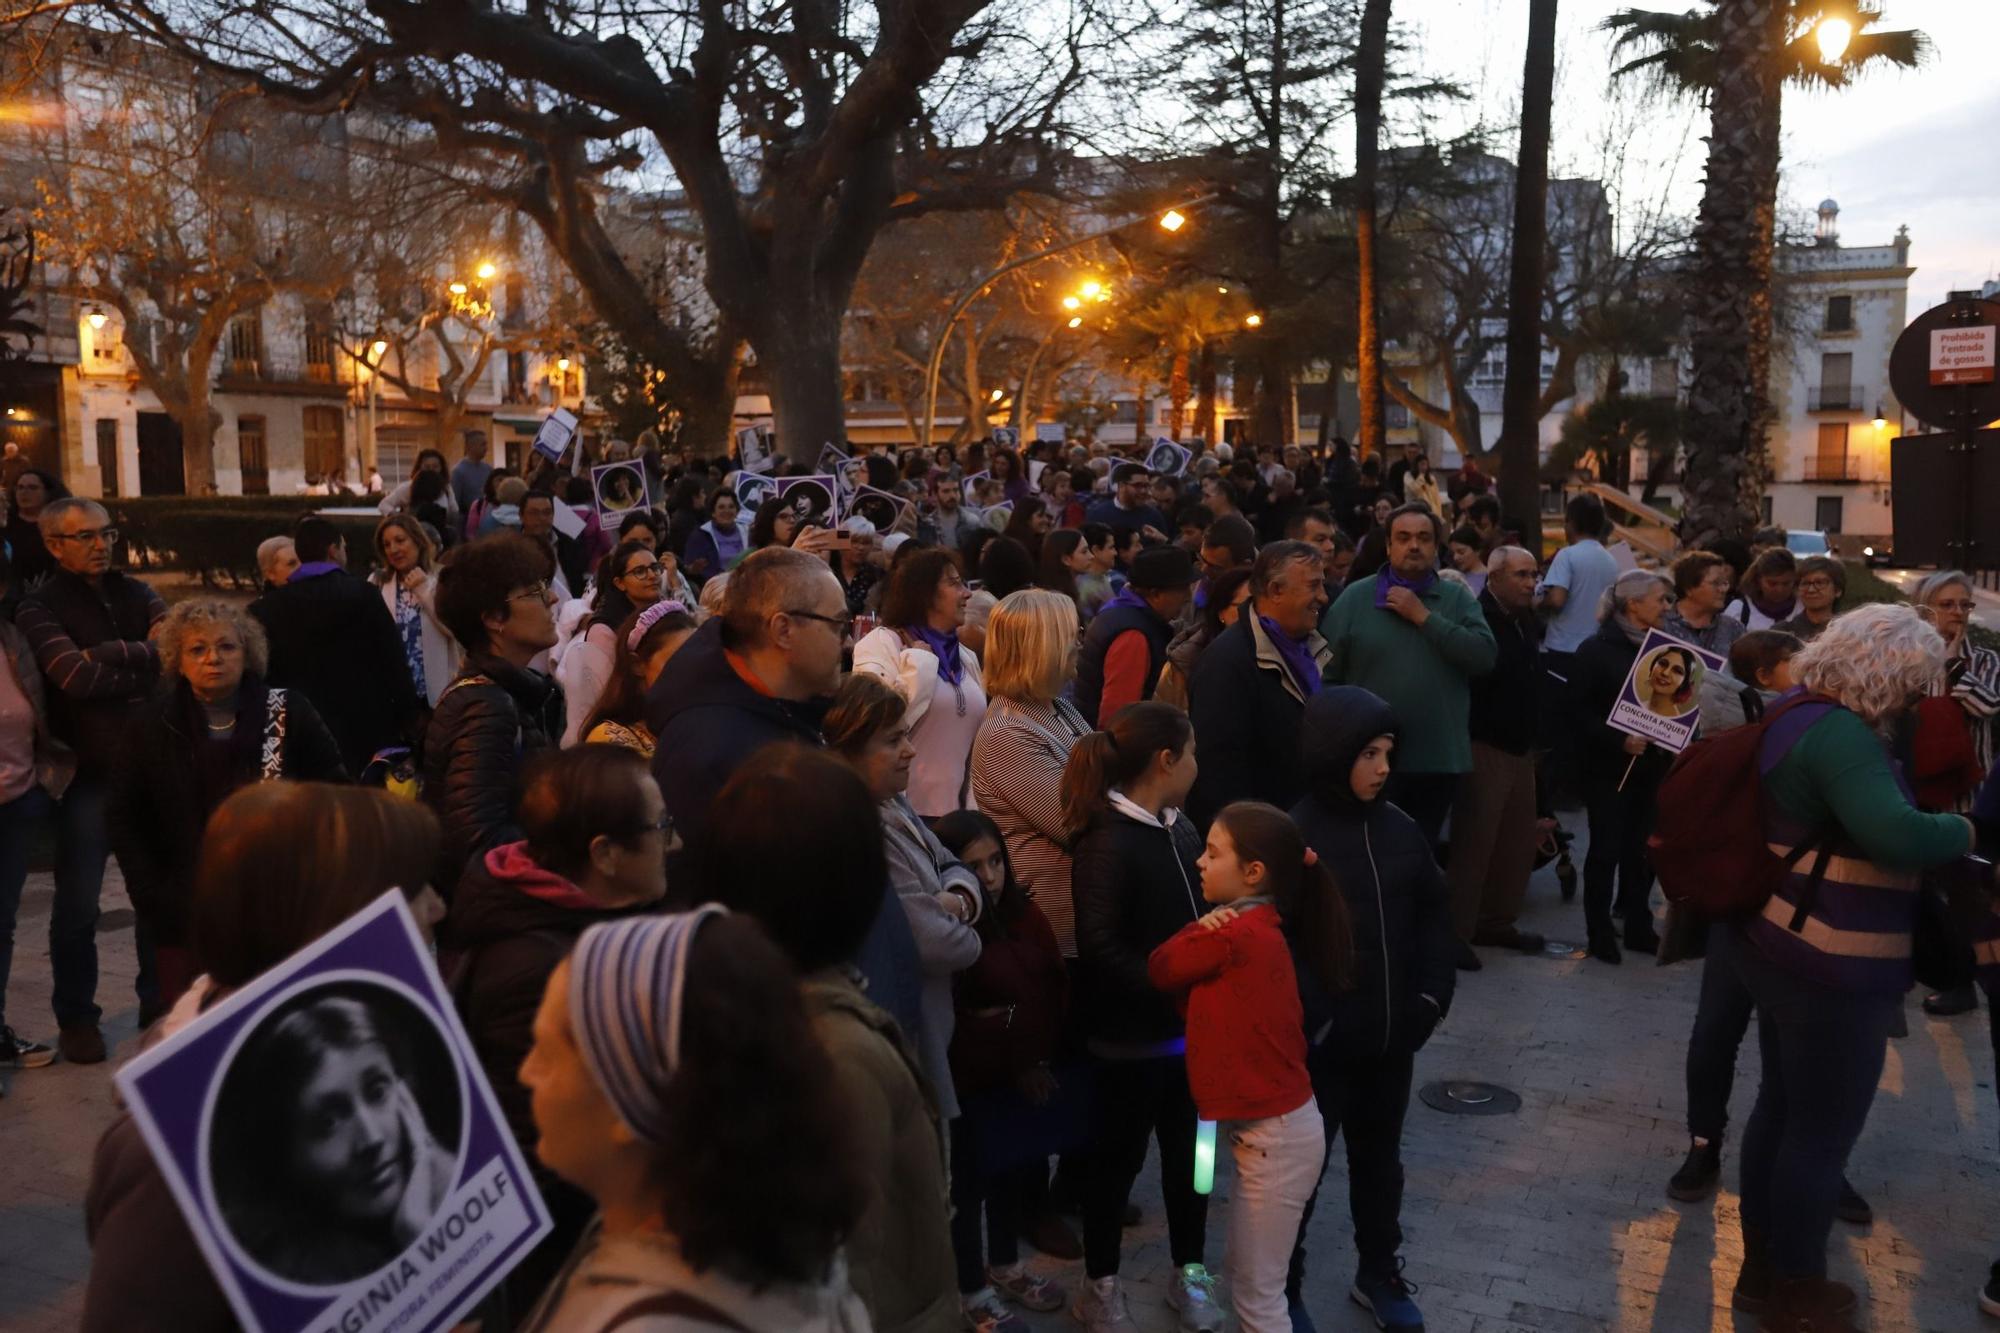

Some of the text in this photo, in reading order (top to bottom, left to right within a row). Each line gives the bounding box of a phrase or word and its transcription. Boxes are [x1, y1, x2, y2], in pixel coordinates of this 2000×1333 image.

[1941, 331, 1985, 342] Prohibida
[1941, 343, 1984, 353] l'entrada
[1939, 355, 1985, 366] de gossos
[1620, 704, 1687, 737] CONCHITA PIQUER
[418, 1171, 507, 1262] WOOLF
[427, 1230, 494, 1295] FEMINISTA
